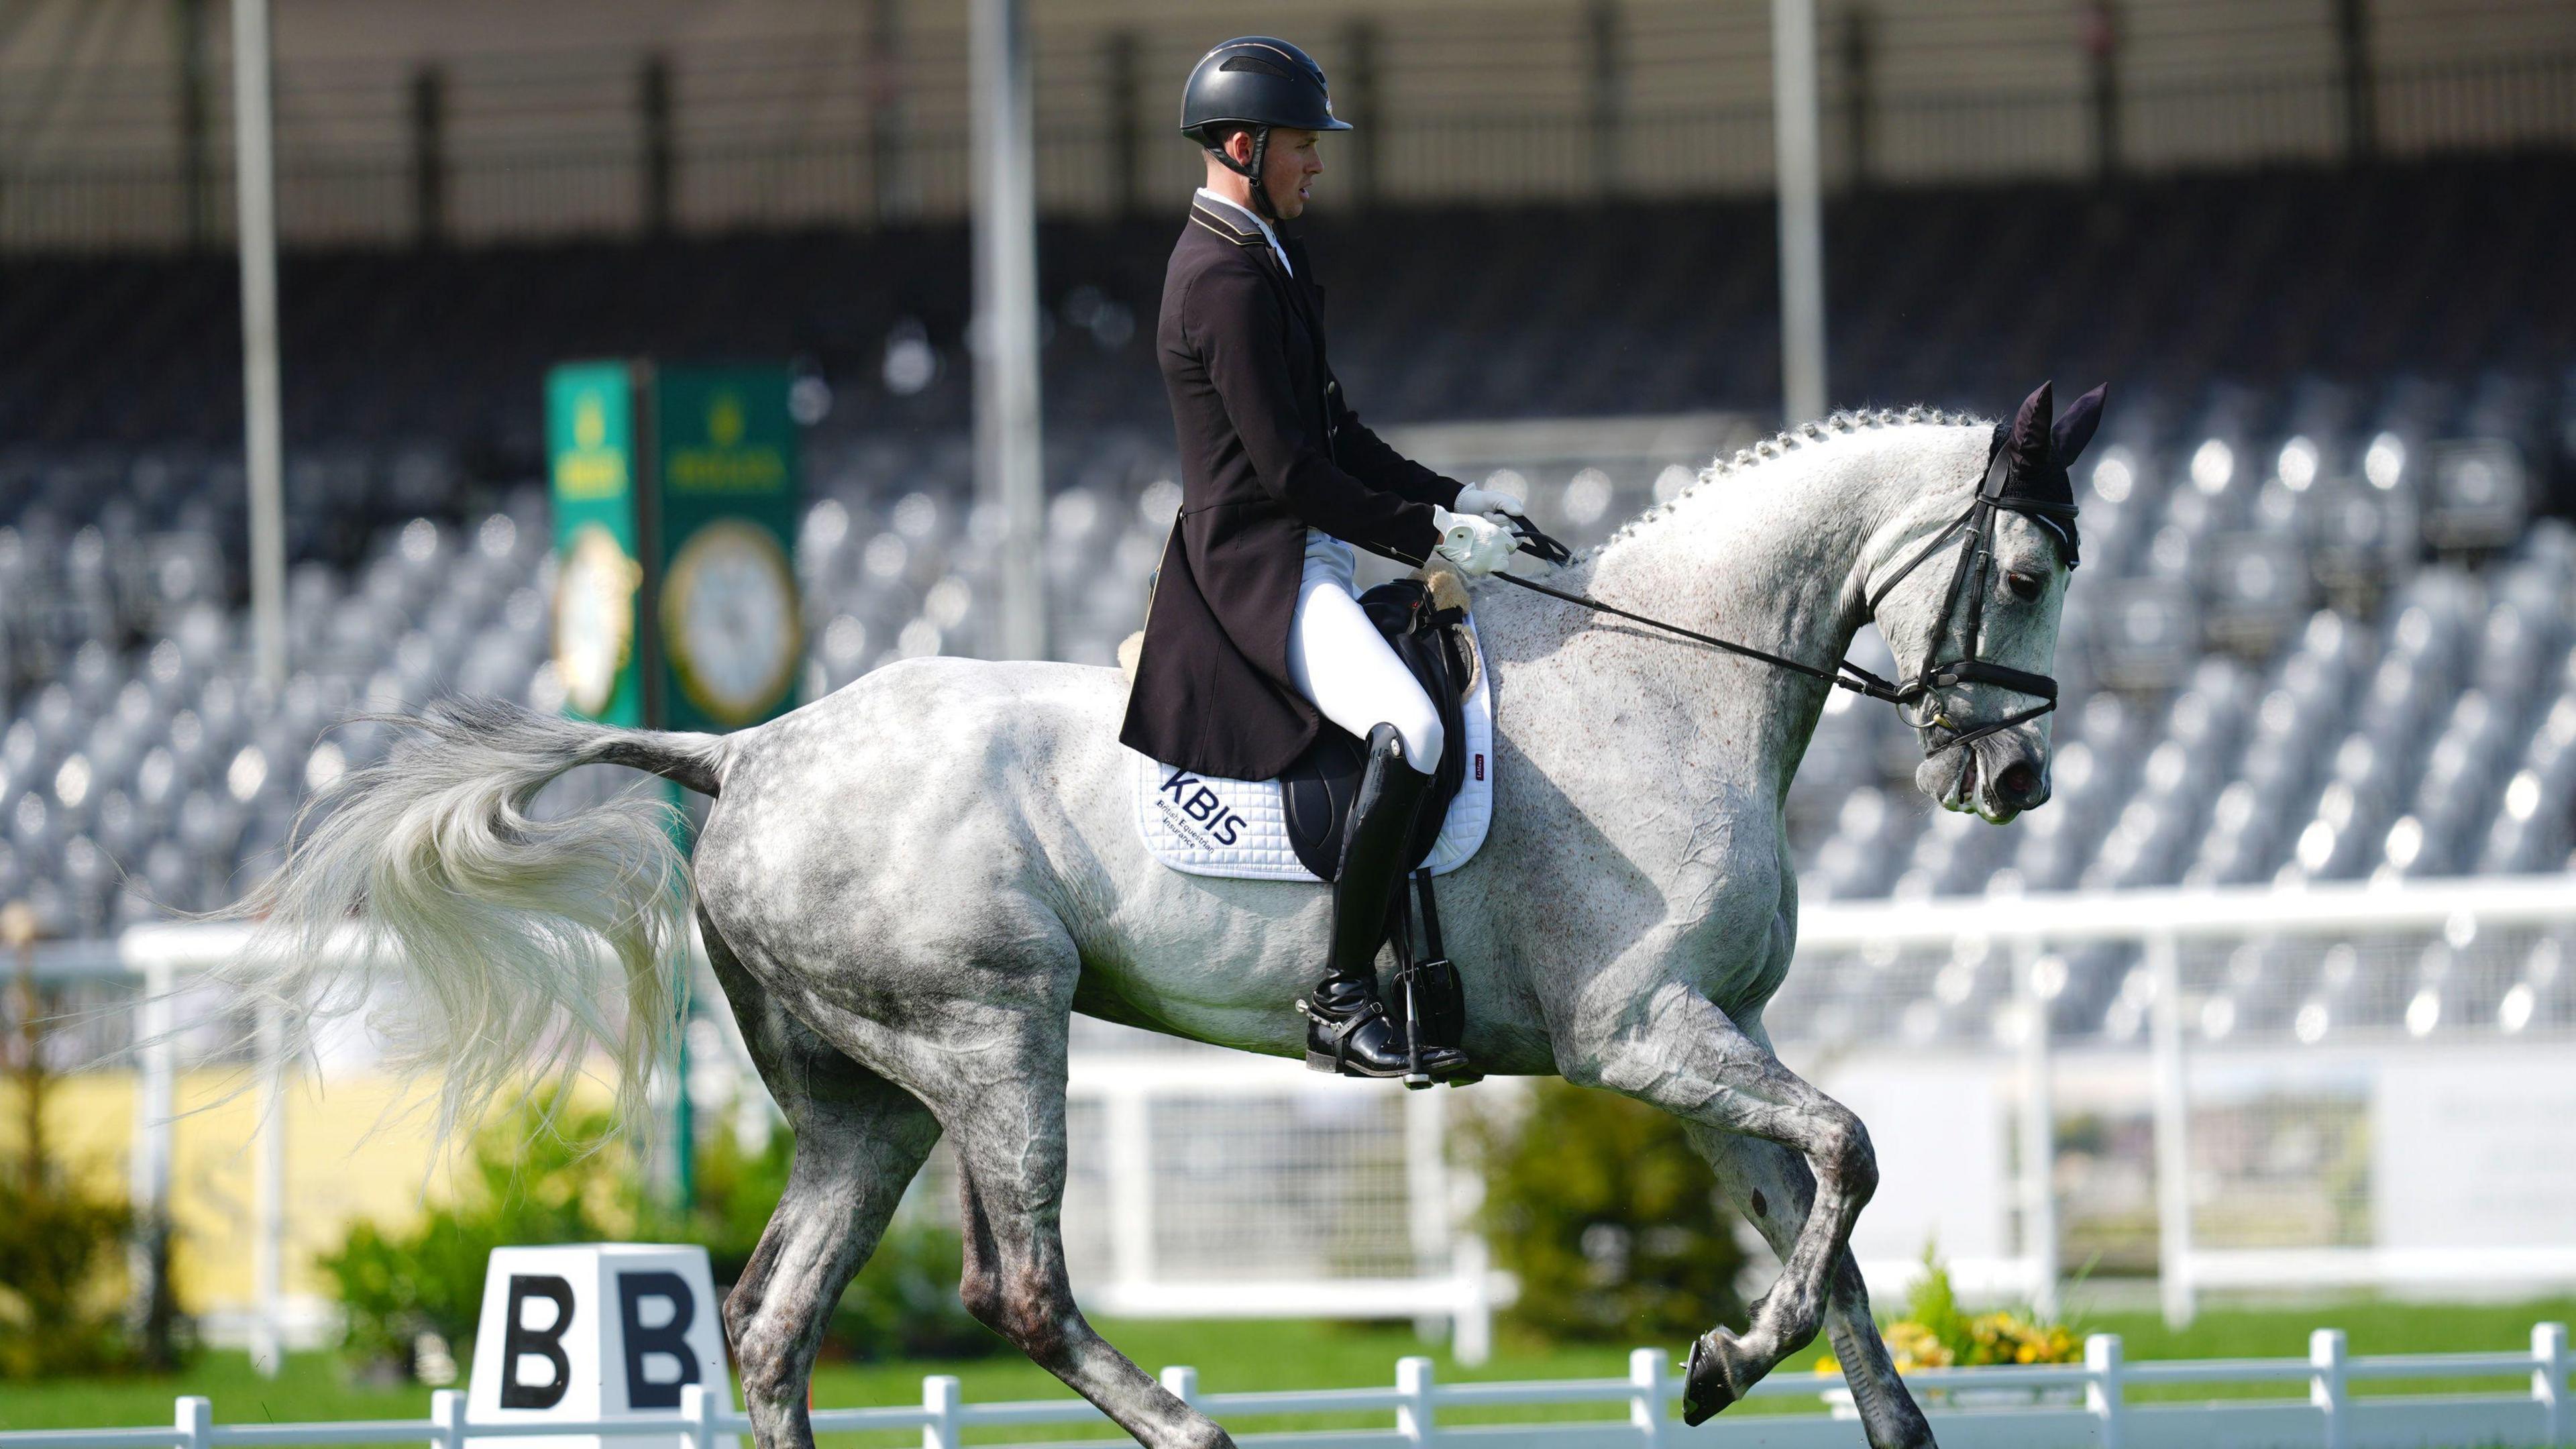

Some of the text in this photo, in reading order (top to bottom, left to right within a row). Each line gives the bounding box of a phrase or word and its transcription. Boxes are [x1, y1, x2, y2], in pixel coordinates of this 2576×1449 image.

[1157, 799, 1215, 854] British Equestrian
[1161, 769, 1248, 846] KBIS
[1163, 816, 1196, 849] Insurance
[500, 1275, 575, 1409] B
[617, 1271, 700, 1408] B
